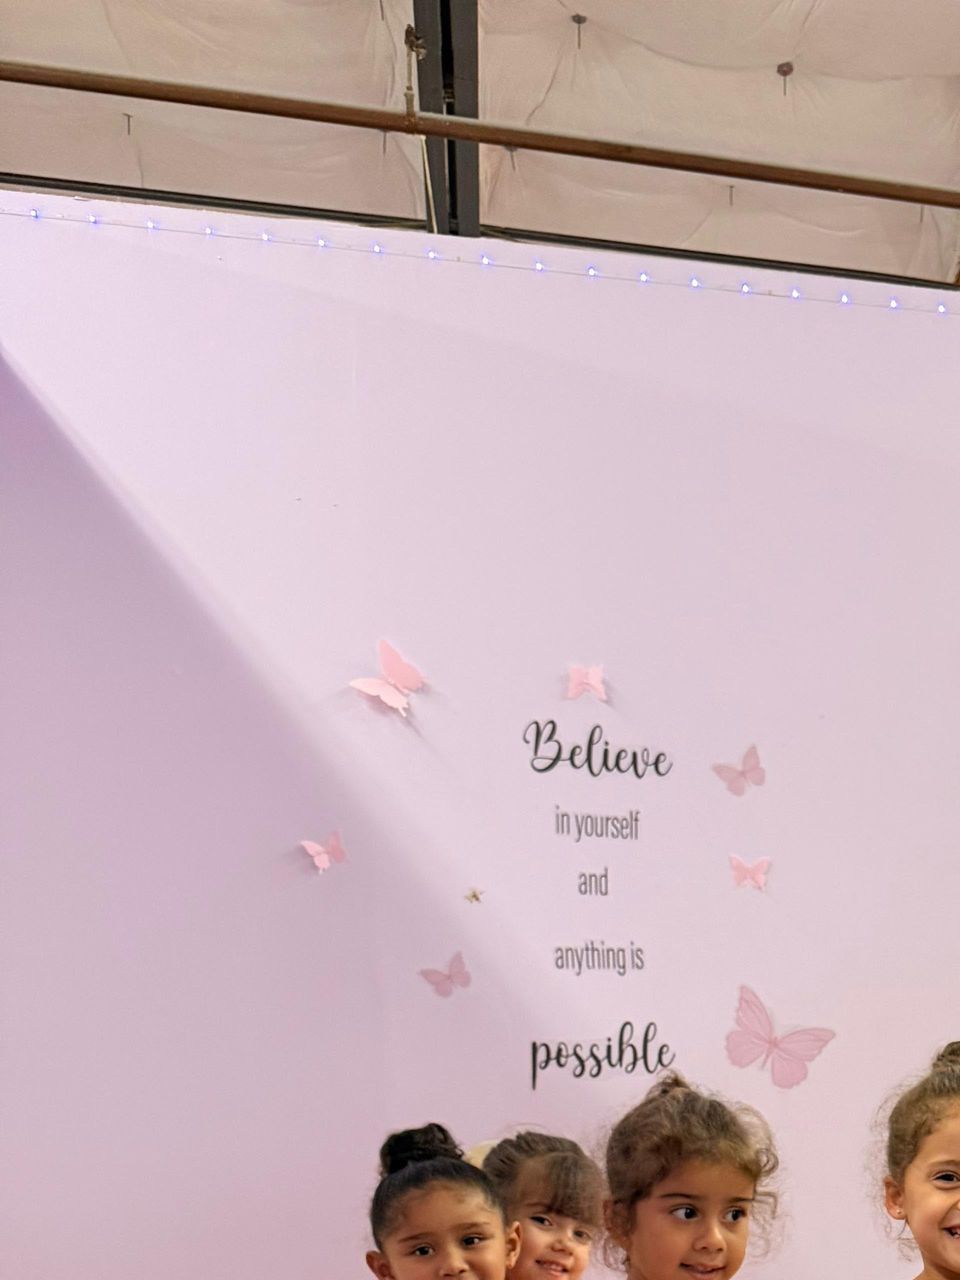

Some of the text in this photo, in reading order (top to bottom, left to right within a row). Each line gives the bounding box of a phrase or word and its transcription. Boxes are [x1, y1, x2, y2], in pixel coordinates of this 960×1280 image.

[523, 719, 673, 779] Believe
[555, 805, 641, 843] in yourself
[577, 867, 609, 897] and
[554, 941, 645, 977] anything is
[530, 1021, 676, 1091] possible
